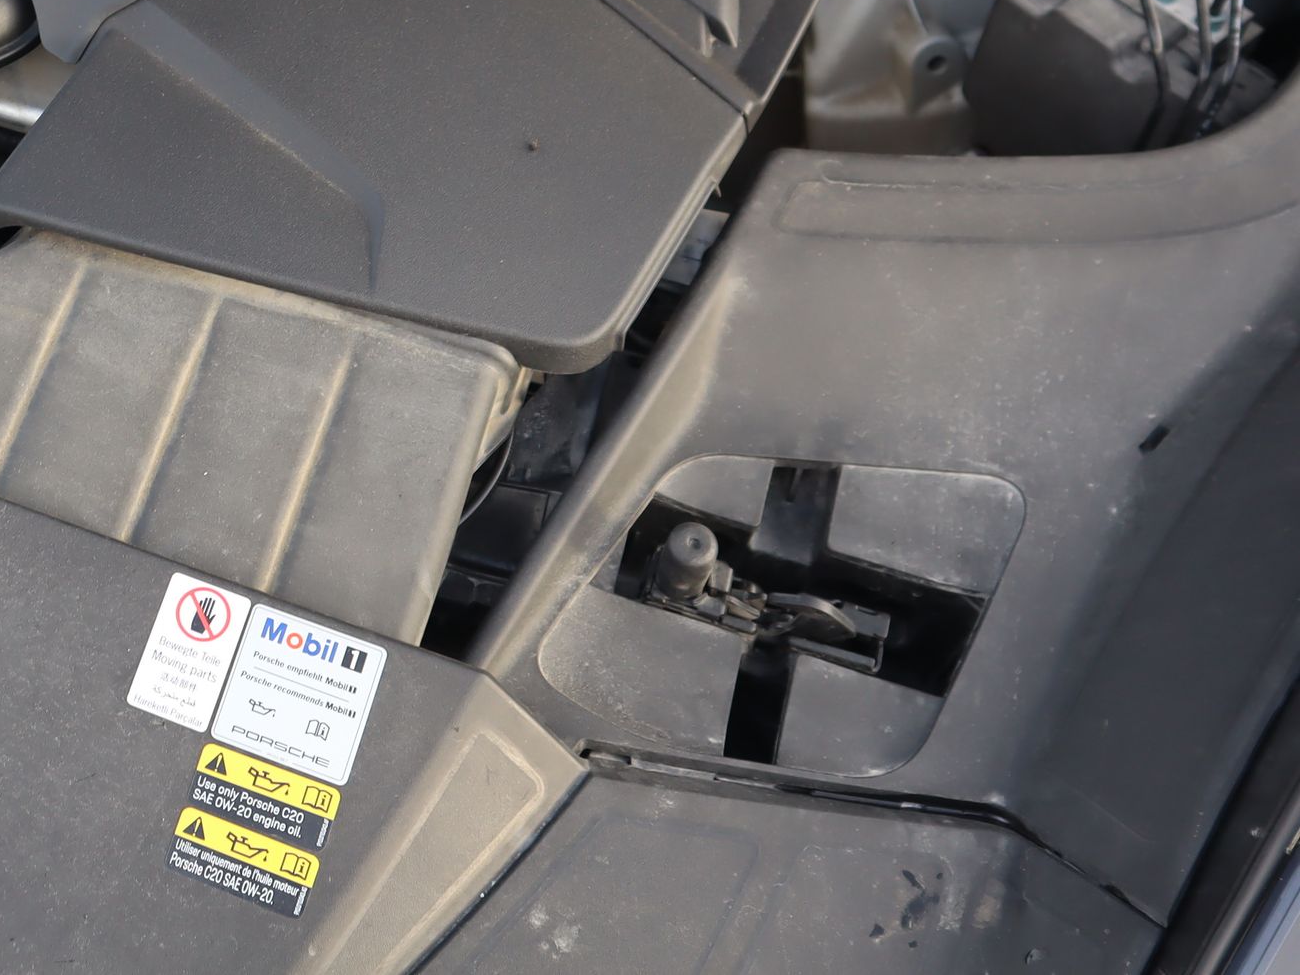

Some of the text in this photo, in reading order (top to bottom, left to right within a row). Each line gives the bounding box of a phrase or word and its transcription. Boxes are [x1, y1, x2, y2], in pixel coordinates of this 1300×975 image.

[159, 635, 221, 666] Bewegte Teile
[260, 617, 339, 663] Mobil
[151, 649, 217, 683] Moving parts
[253, 650, 285, 667] Porsche
[286, 664, 323, 682] empfiehlt
[325, 676, 348, 691] Mobil
[240, 670, 272, 688] Porsche
[273, 683, 324, 707] recommends
[325, 701, 348, 716] Mobil
[231, 725, 330, 768] PORSCHE
[192, 788, 215, 805] SAE
[215, 796, 252, 819] 0W-20
[252, 812, 286, 831] engine
[287, 825, 302, 838] oil.
[197, 775, 304, 824] Use only Porsche C20
[169, 852, 203, 876] Porsche
[203, 866, 223, 884] C20
[222, 873, 243, 892] SAE
[175, 838, 300, 897] Utiliser uniquement de l'huile moteur
